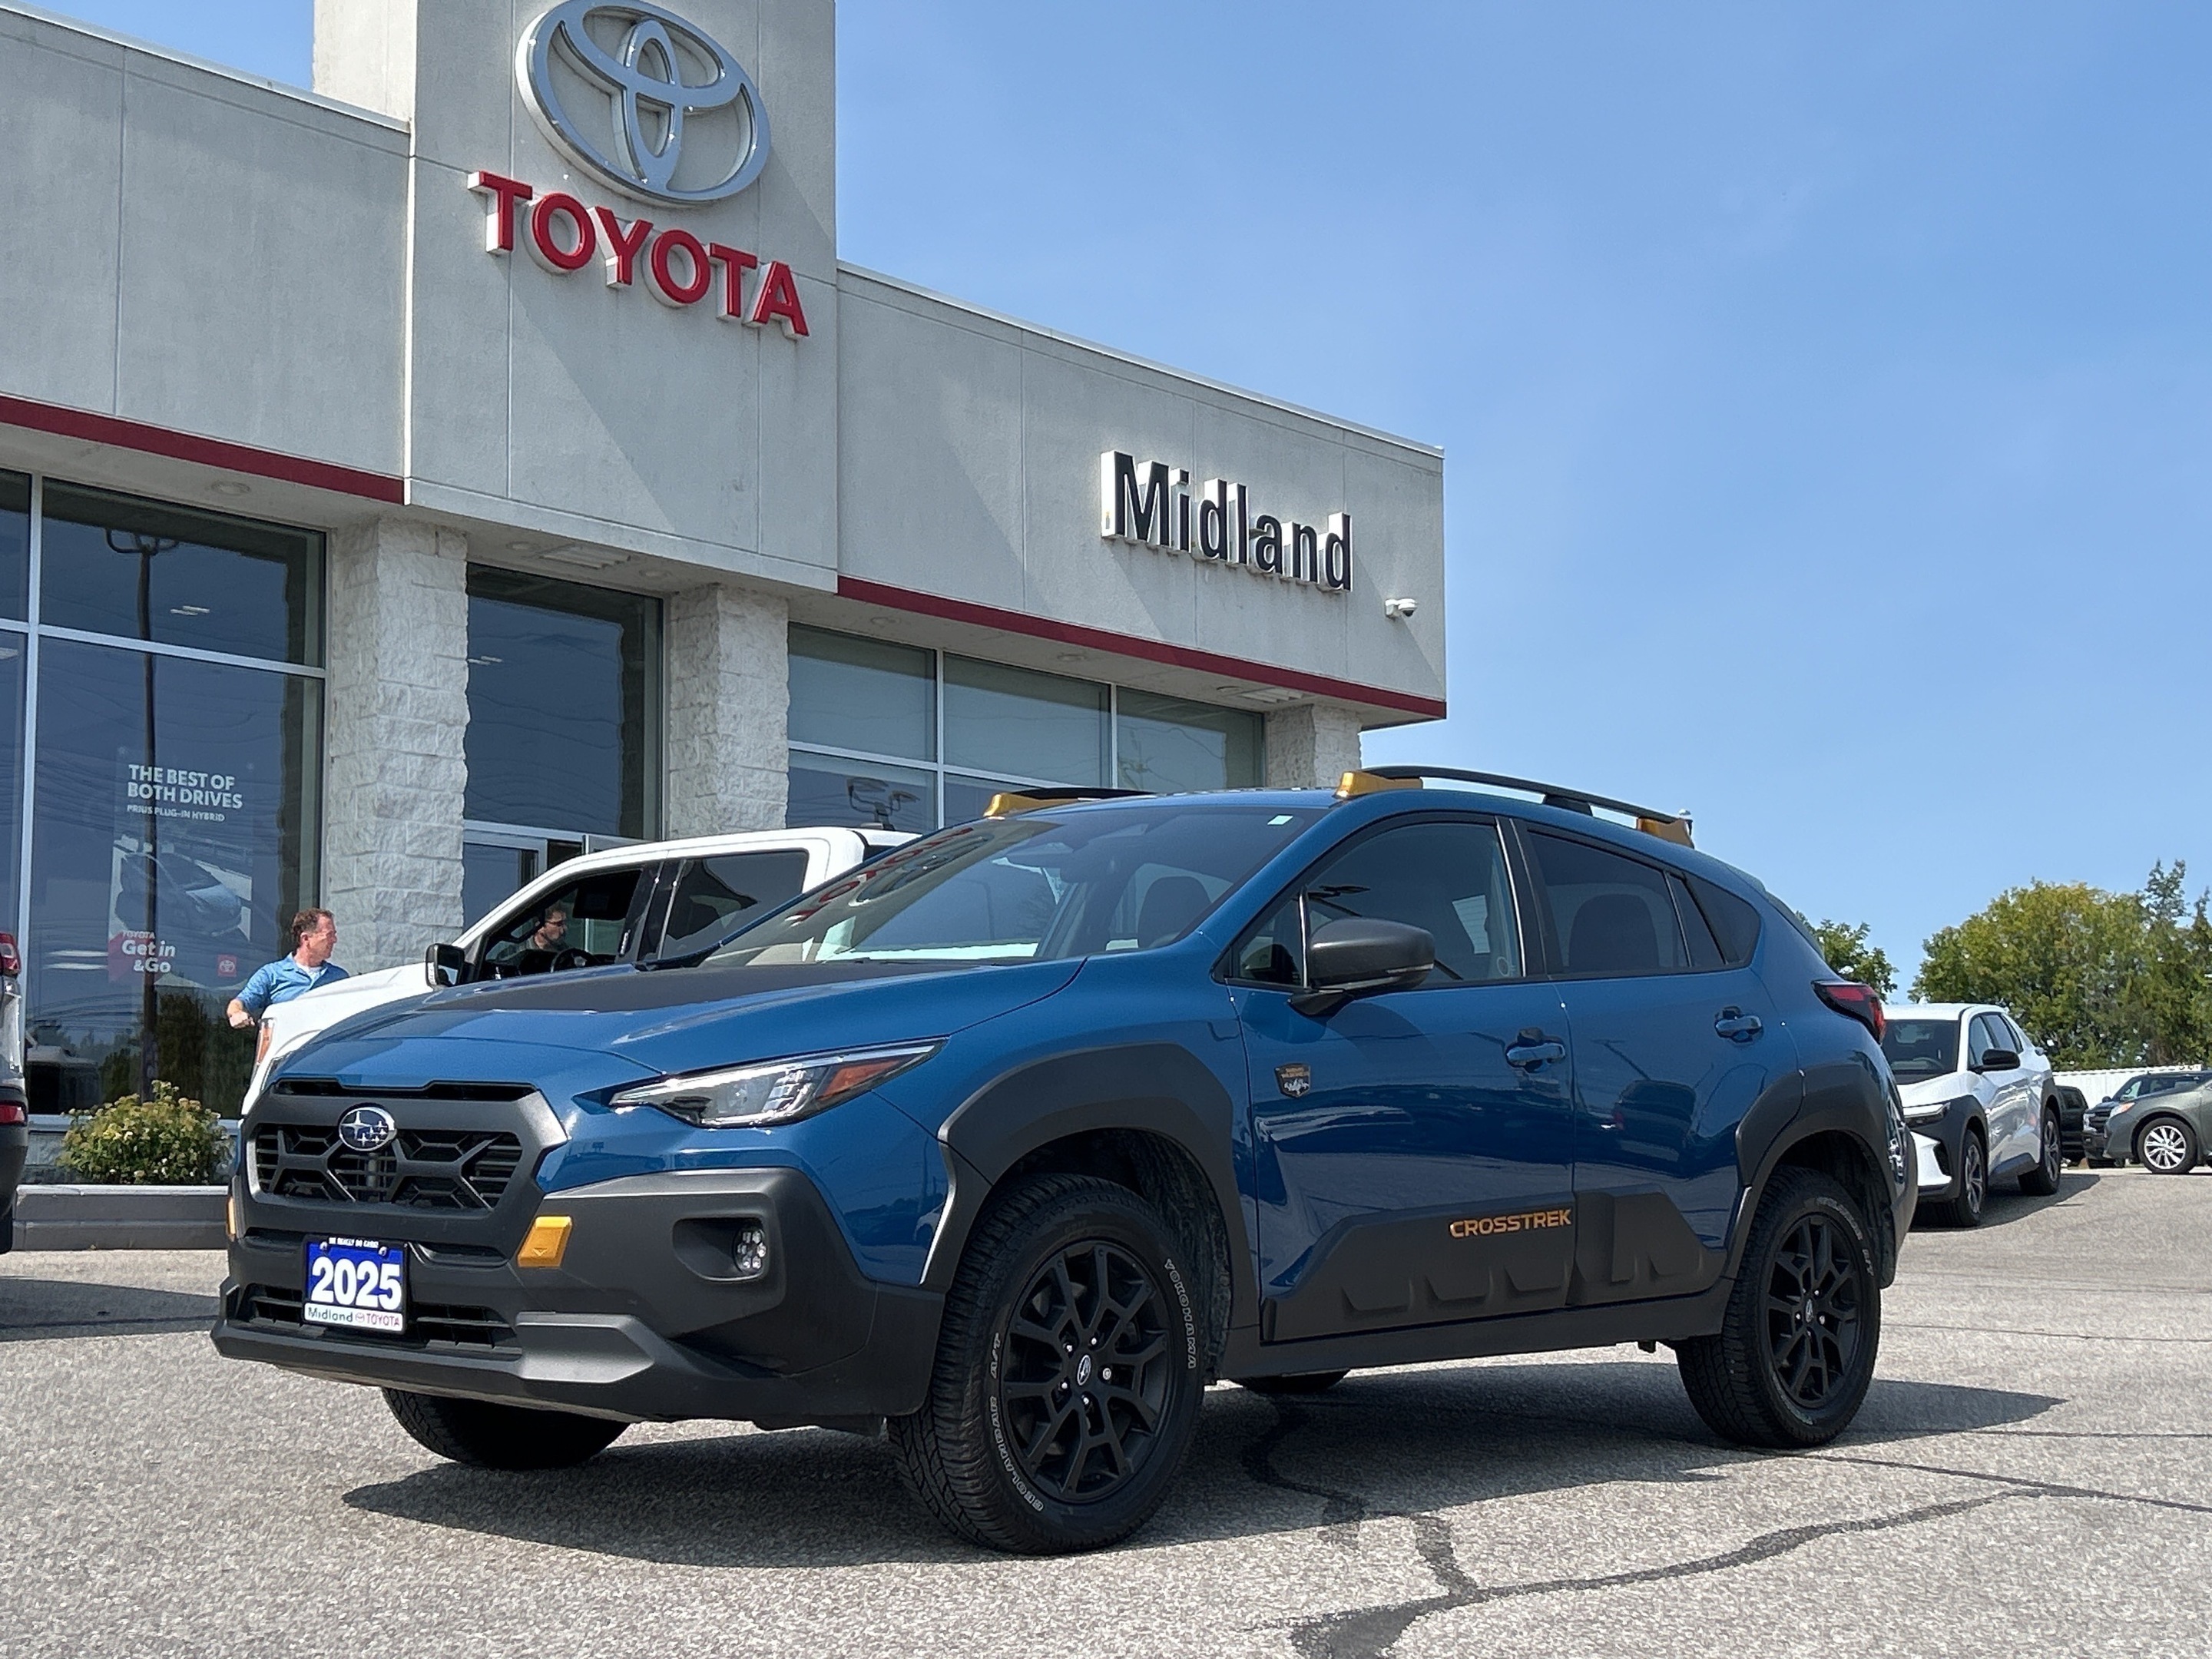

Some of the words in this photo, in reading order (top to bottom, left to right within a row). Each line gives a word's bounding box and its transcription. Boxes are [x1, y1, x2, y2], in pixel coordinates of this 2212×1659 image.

[470, 171, 810, 340] TOYOTA
[1104, 450, 1353, 592] Midland
[128, 764, 164, 783] THE
[167, 769, 208, 788] BEST
[210, 773, 235, 790] OF
[127, 782, 176, 802] BOTH
[180, 788, 243, 809] DRIVES
[127, 804, 154, 815] PRIUS
[154, 806, 190, 819] PLUG-IN
[191, 810, 225, 822] HYBRID
[121, 939, 156, 956] Get
[159, 940, 176, 958] in
[1449, 1208, 1572, 1238] CROSSTREK
[310, 1256, 402, 1310] 2025
[308, 1306, 353, 1323] Midland
[366, 1313, 400, 1327] TOYOTA
[1164, 1257, 1197, 1369] YOKOHAMA
